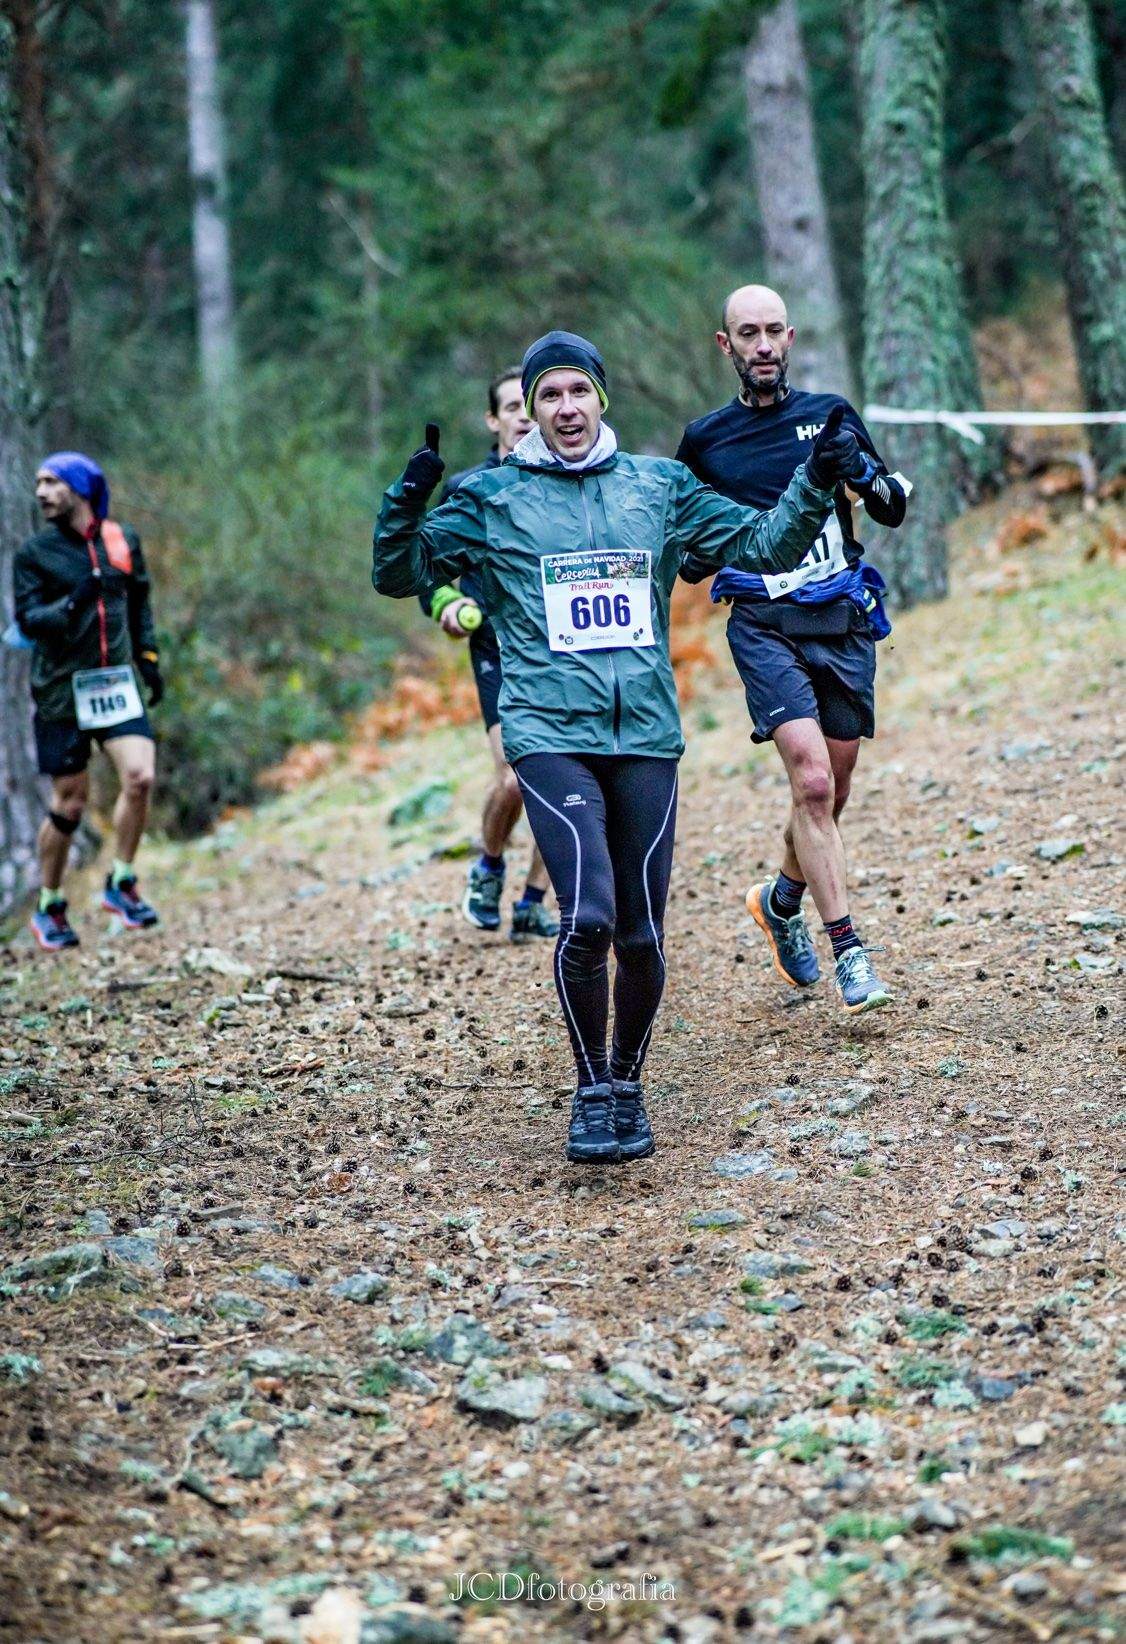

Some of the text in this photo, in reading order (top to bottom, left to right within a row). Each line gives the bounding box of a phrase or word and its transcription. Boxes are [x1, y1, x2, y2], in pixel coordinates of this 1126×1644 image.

[548, 558, 583, 568] CARRERA
[594, 555, 627, 563] NAVIDAD
[629, 555, 644, 563] 2021
[570, 593, 631, 630] 606
[89, 695, 127, 714] 1149
